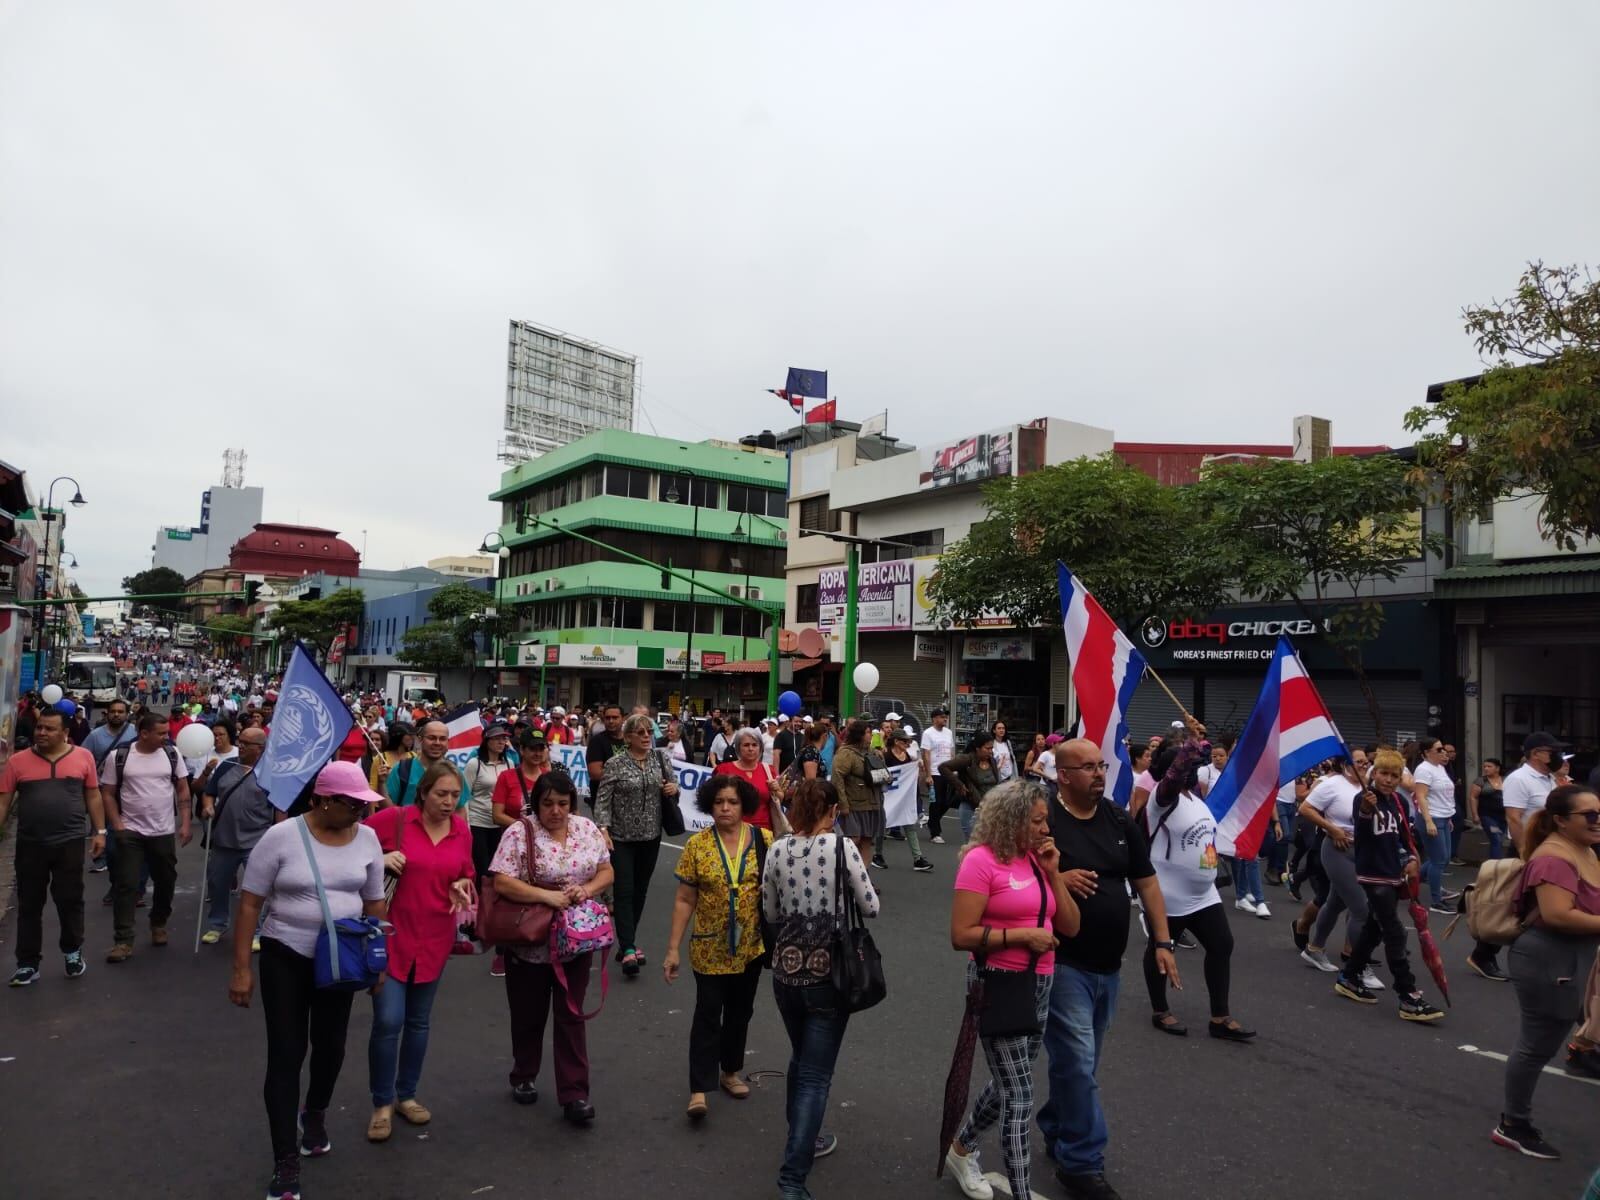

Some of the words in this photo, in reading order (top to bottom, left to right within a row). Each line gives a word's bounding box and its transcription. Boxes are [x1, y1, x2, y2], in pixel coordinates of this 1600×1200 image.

[820, 571, 846, 590] ROPA
[857, 565, 911, 586] MERICANA
[858, 587, 893, 602] Avenida
[1173, 650, 1205, 659] KOREA'S
[1206, 650, 1233, 659] FINEST
[1234, 650, 1259, 659] FRIED
[1373, 810, 1403, 835] GA
